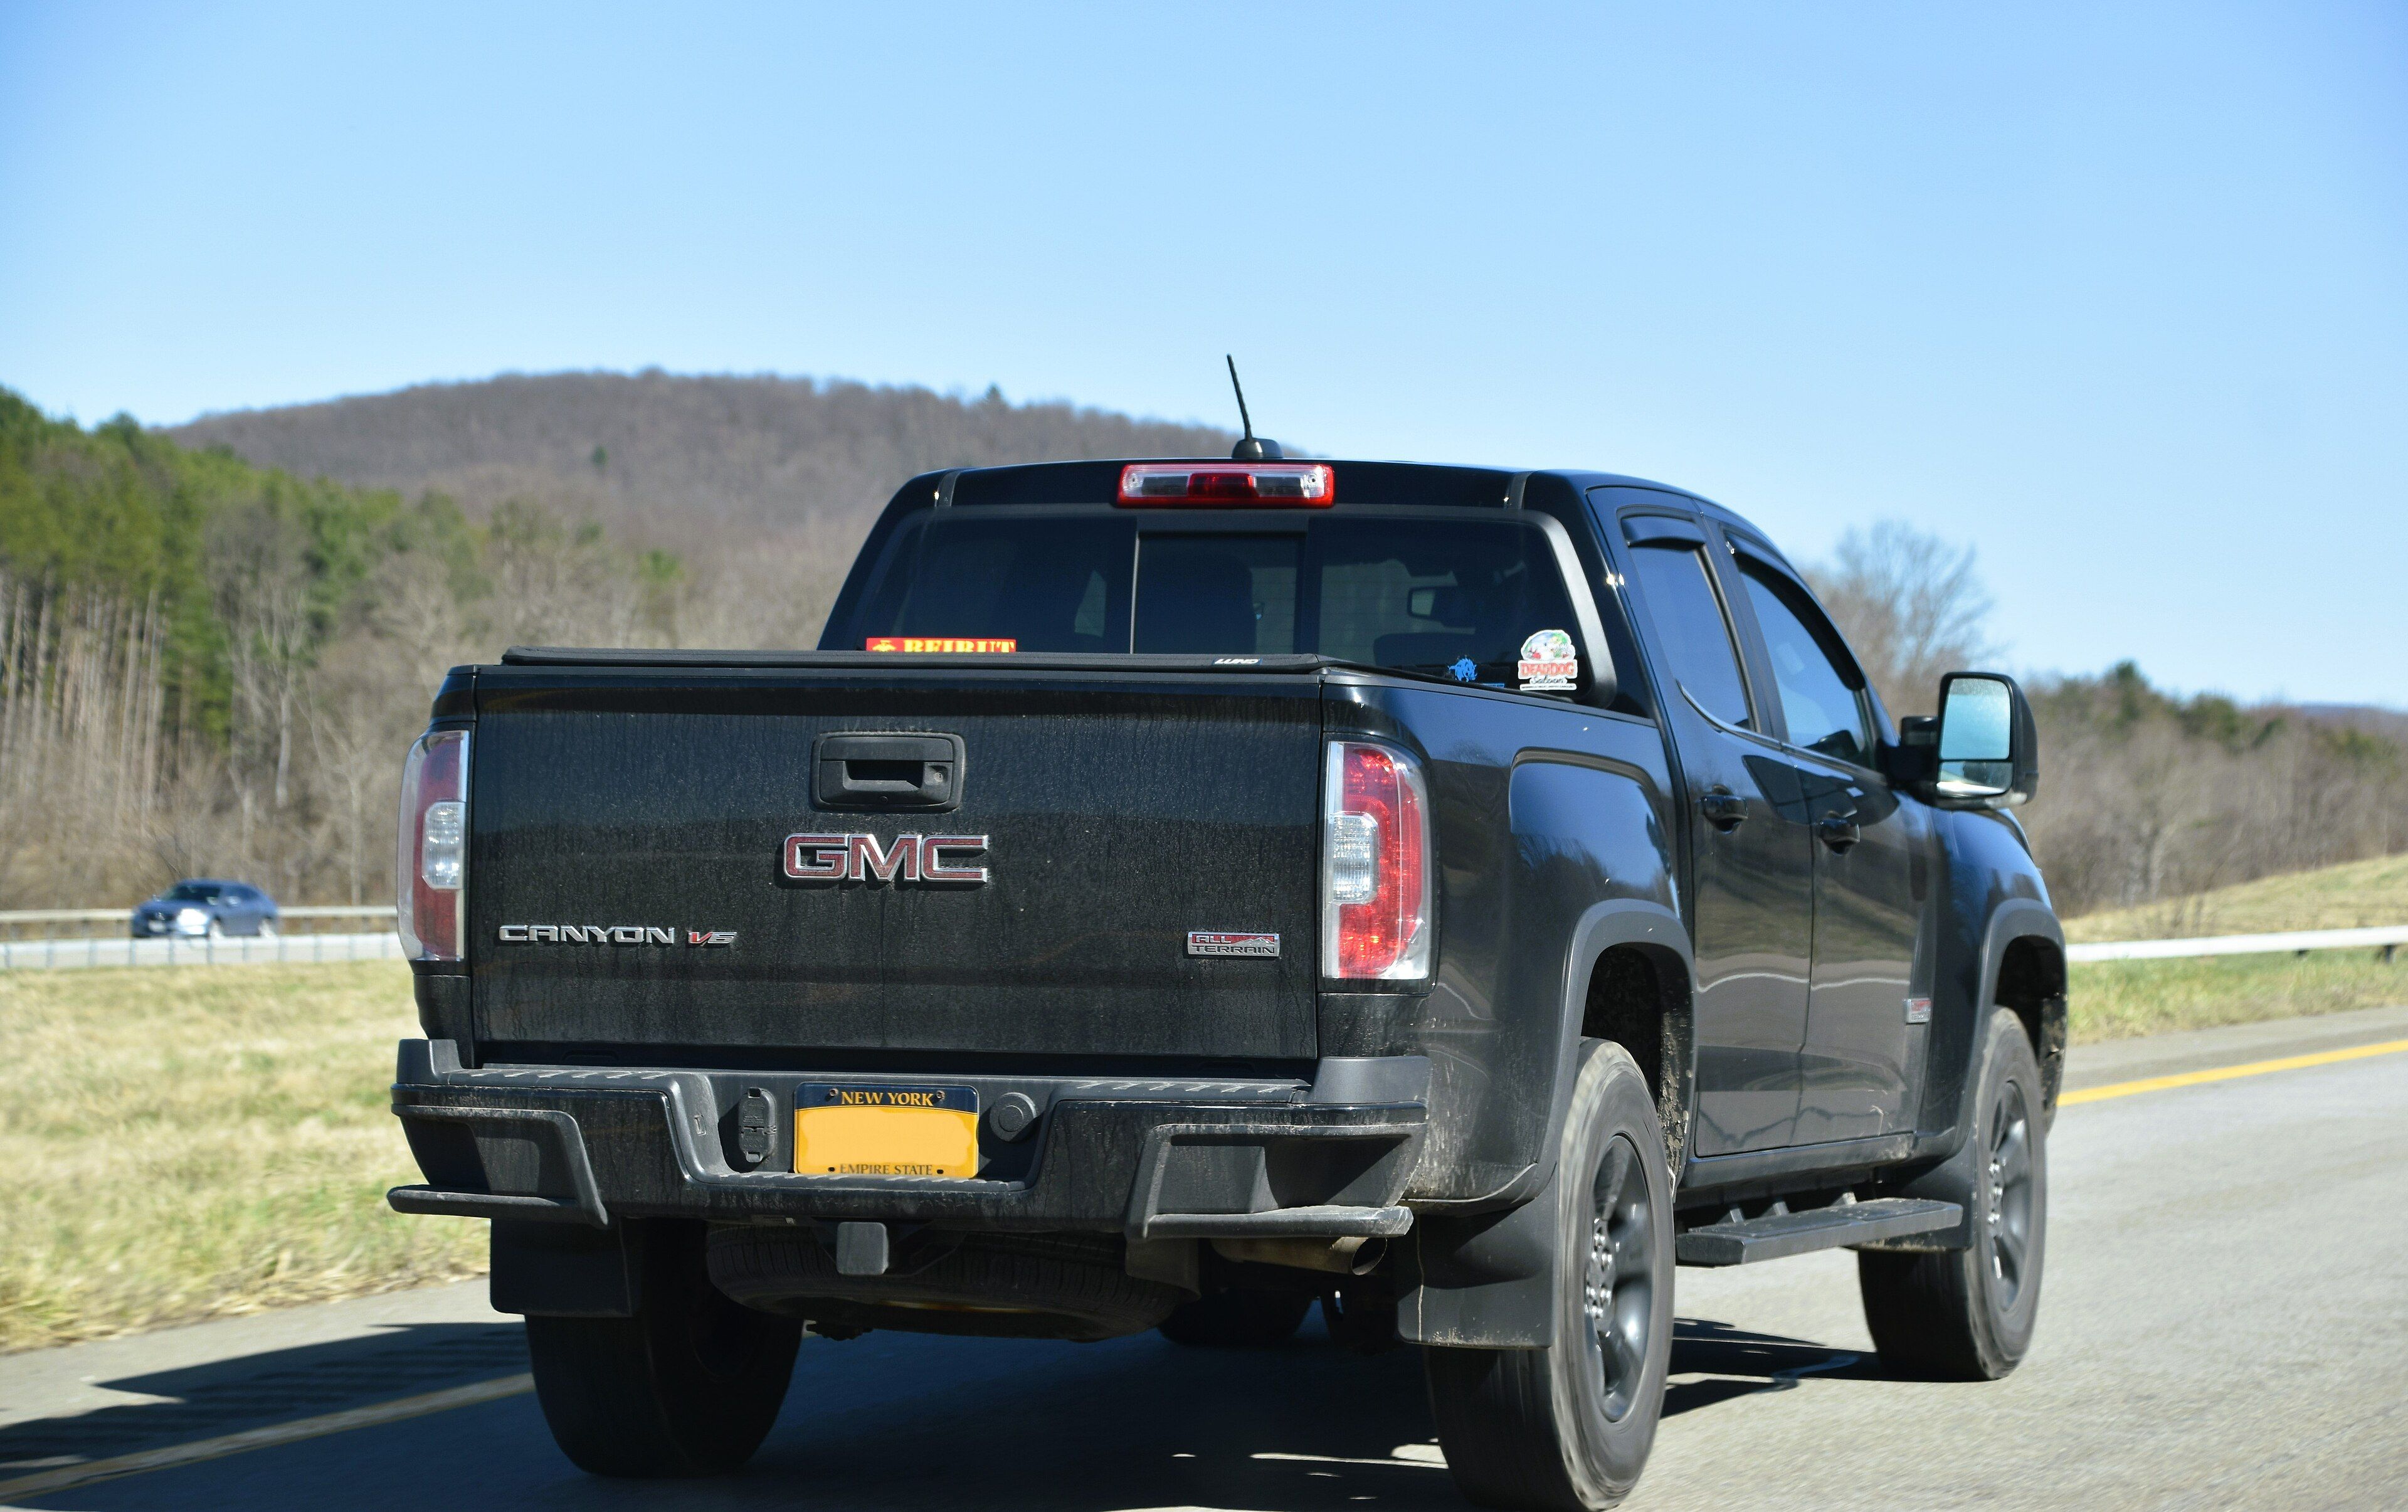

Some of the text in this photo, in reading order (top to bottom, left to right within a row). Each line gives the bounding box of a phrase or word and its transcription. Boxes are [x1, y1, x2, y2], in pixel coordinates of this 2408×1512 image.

[904, 640, 1015, 653] BEIRUT
[784, 833, 989, 882] GMC
[499, 925, 737, 944] CANYON V6
[1196, 935, 1232, 943] ALL
[1192, 945, 1275, 954] TERRAIN
[841, 1091, 934, 1106] NEW YORK
[840, 1163, 932, 1176] EMPIRE STATE
